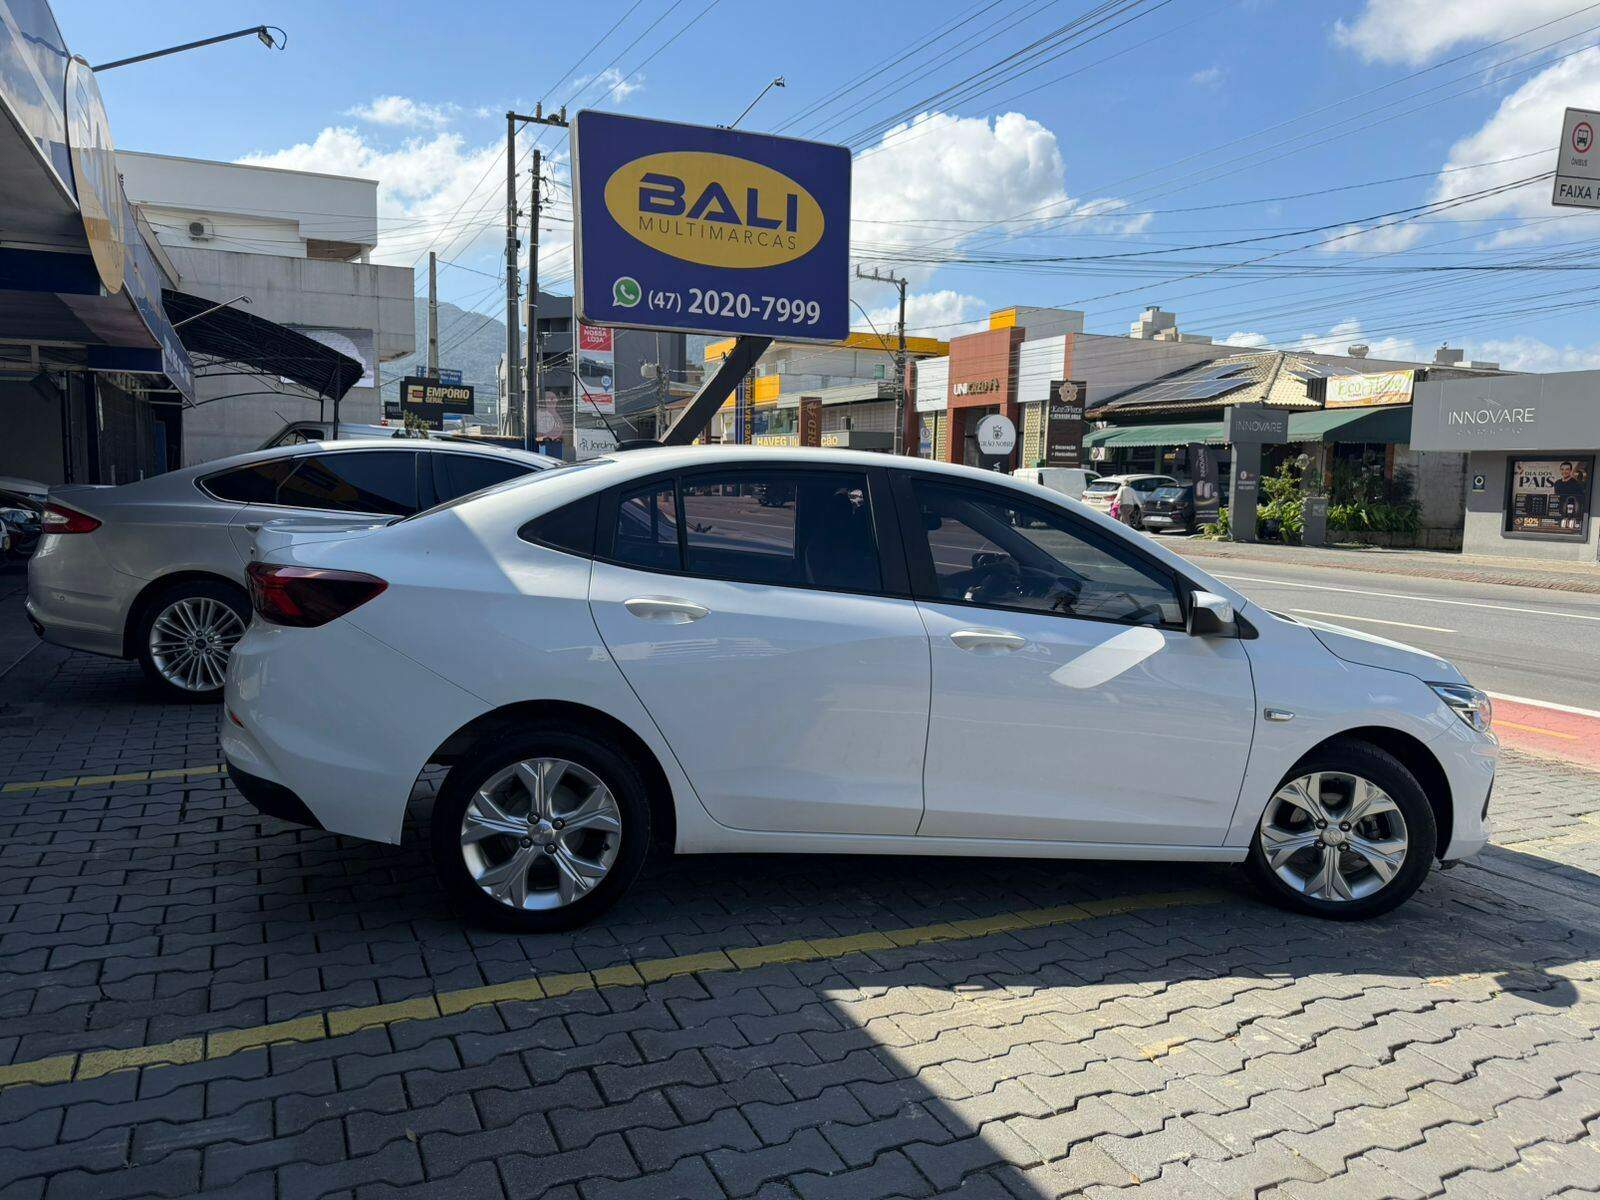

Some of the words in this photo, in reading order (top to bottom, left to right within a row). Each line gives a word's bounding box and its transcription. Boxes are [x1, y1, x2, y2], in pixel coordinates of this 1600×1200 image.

[1559, 184, 1592, 199] FAIXA
[638, 172, 798, 232] BALI
[638, 216, 796, 250] MULTIMARCAS
[648, 289, 682, 312] (47)
[687, 287, 821, 325] 2020-7999
[583, 329, 608, 337] NOSSA
[426, 386, 470, 400] EMPÓRIO
[1448, 407, 1536, 425] INNOVARE
[1235, 420, 1283, 433] INNOVARE
[1519, 476, 1555, 488] PAIS
